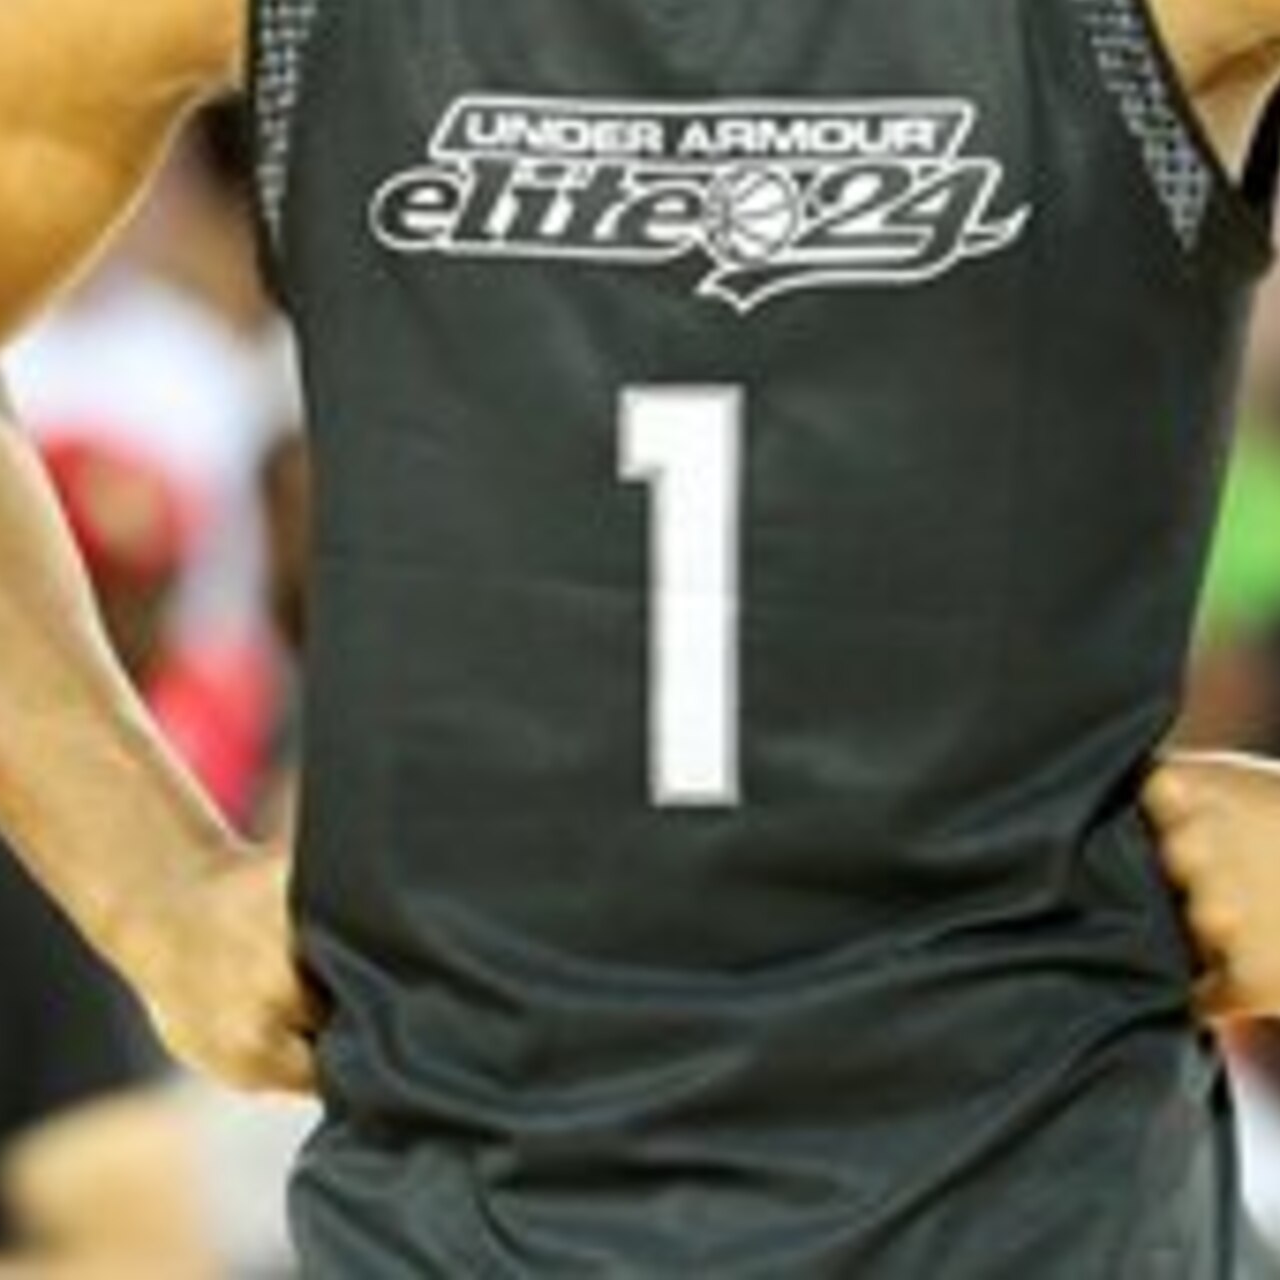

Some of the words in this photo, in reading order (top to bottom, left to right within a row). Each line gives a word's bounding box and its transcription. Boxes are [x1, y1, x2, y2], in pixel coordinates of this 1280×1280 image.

[463, 110, 664, 155] UNDER
[677, 116, 937, 156] ARMOUR
[368, 158, 720, 264] elite
[802, 158, 1026, 280] 24
[617, 384, 744, 808] 1
